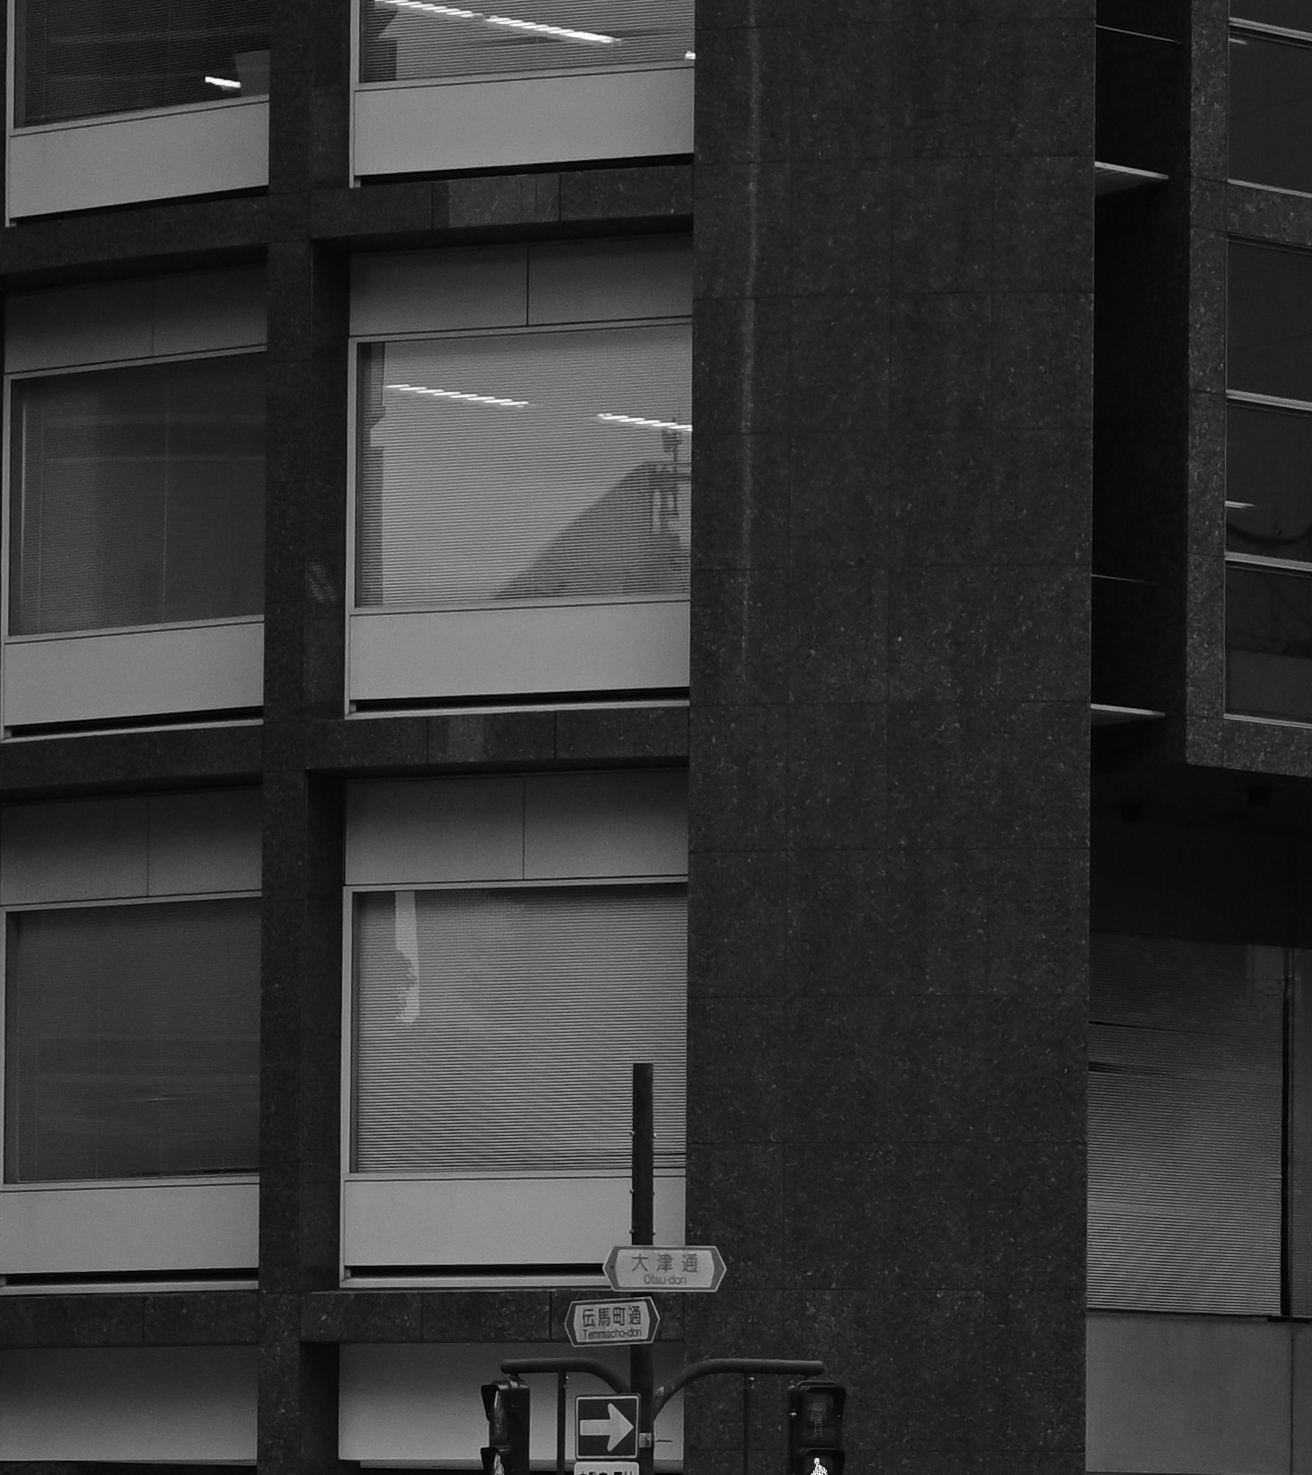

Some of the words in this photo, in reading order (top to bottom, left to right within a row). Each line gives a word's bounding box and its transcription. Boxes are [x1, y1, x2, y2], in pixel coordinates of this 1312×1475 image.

[632, 1253, 698, 1273] 大津通
[643, 1273, 687, 1285] Otsu-dori
[582, 1306, 641, 1328] 伝馬町通
